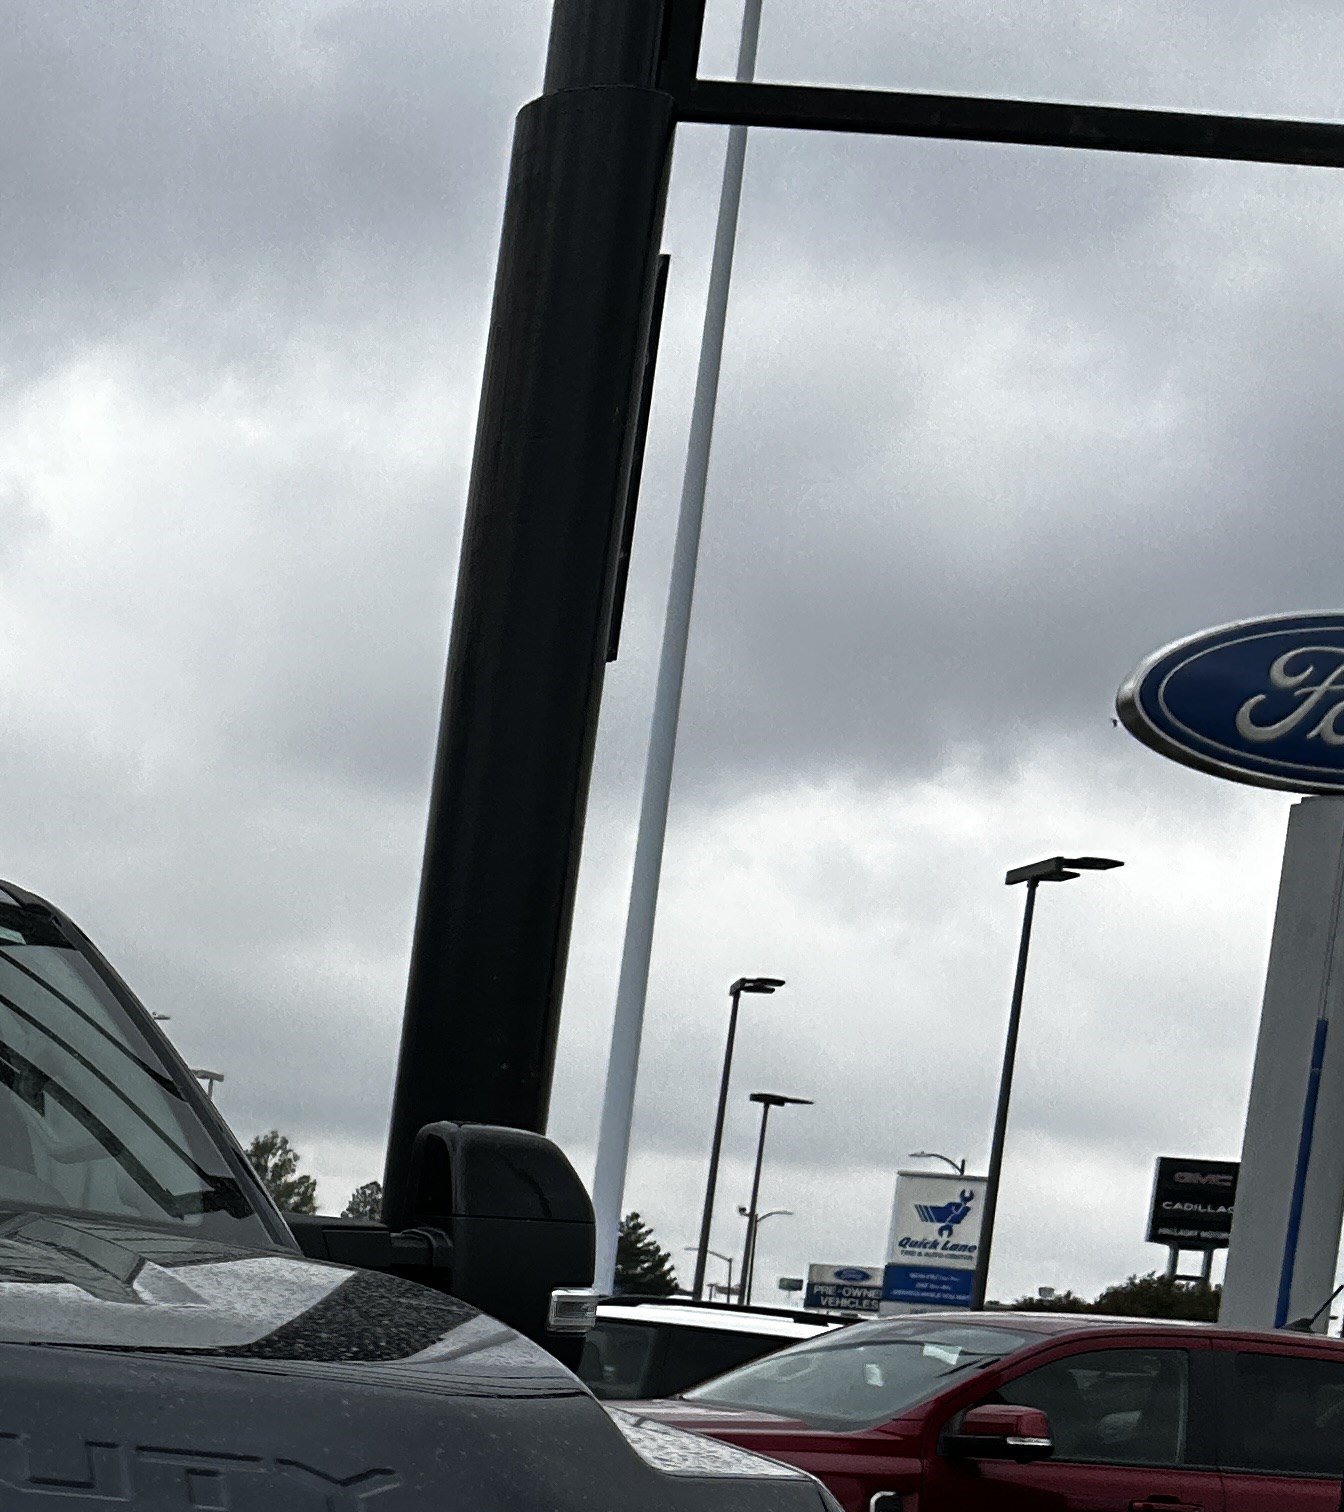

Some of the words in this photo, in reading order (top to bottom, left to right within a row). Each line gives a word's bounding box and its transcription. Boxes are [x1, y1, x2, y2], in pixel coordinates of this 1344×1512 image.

[898, 1236, 940, 1249] Quick
[941, 1240, 978, 1253] Lane
[813, 1285, 882, 1299] PRE-OWNE
[820, 1296, 880, 1310] VEHICLES
